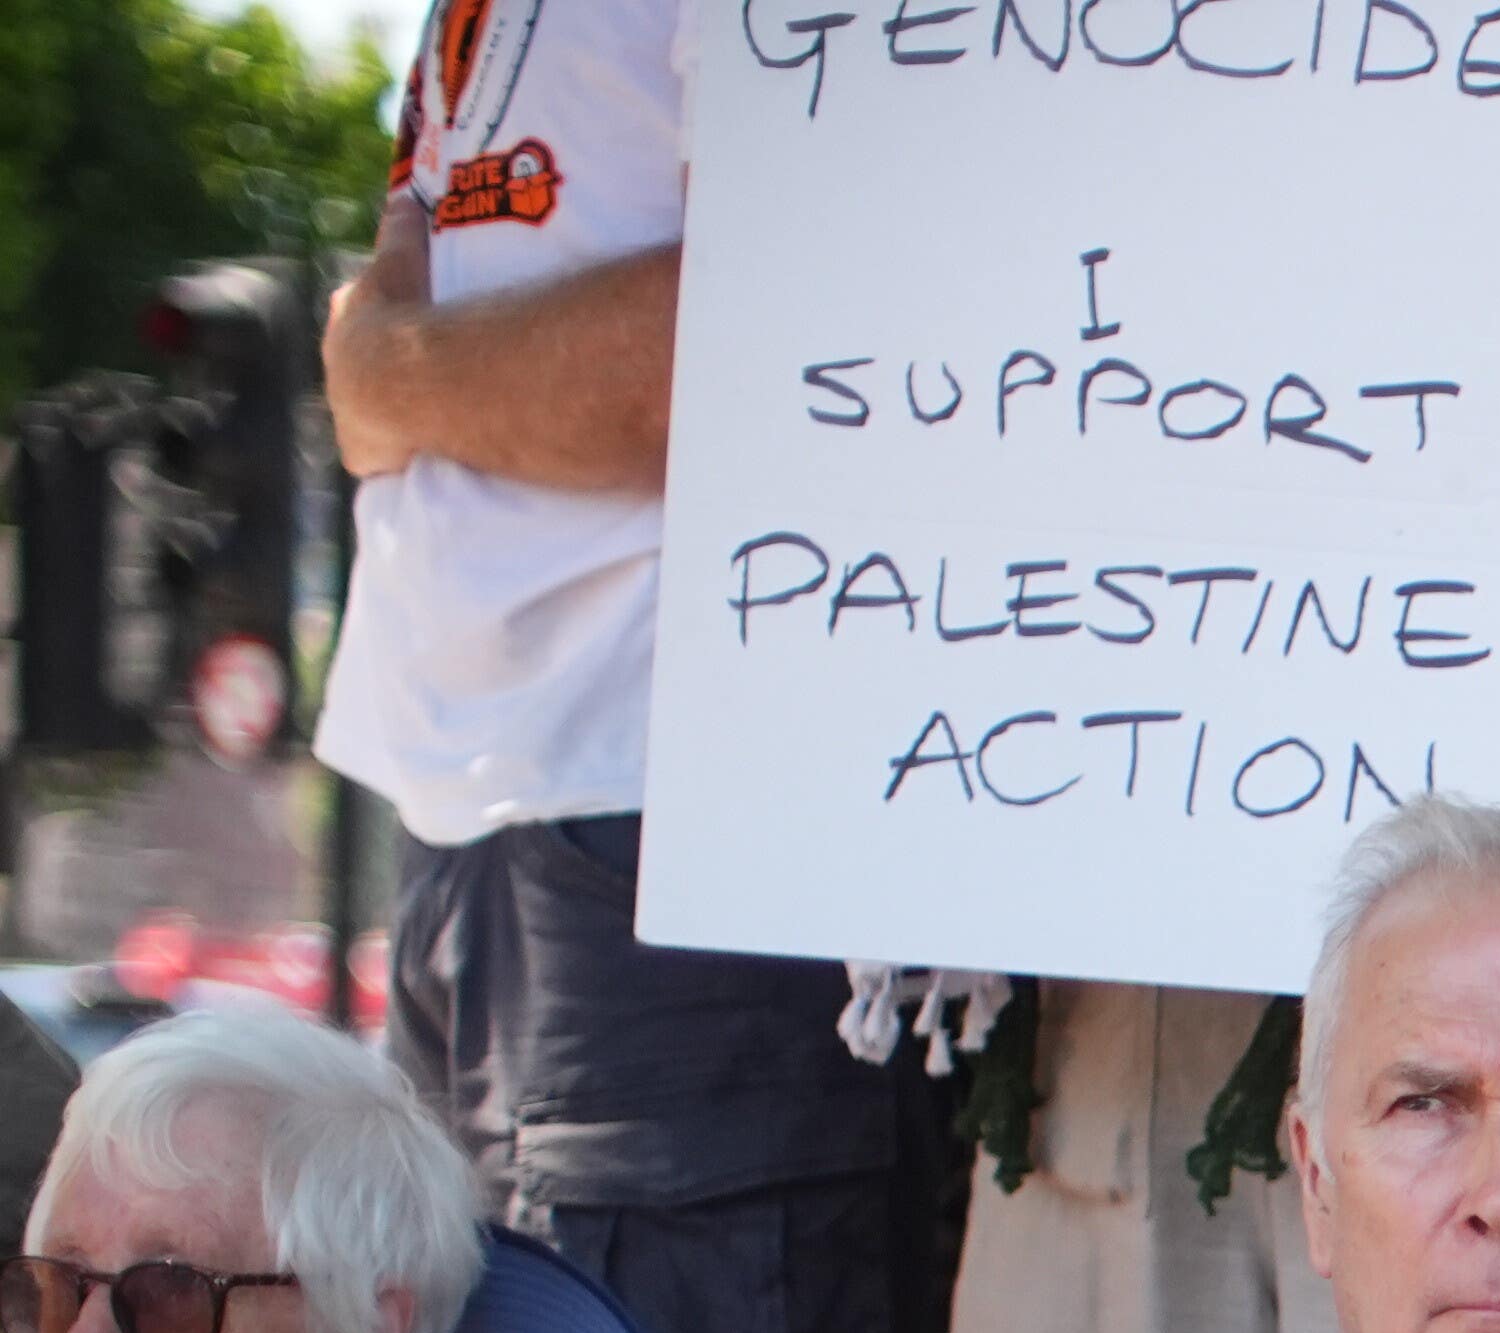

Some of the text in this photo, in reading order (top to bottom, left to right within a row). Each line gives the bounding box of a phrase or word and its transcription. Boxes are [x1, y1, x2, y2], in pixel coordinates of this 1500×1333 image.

[1078, 247, 1121, 340] I
[803, 350, 1459, 462] SUPPORT
[726, 532, 1491, 668] PALESTINE
[885, 711, 1435, 823] ACTION
